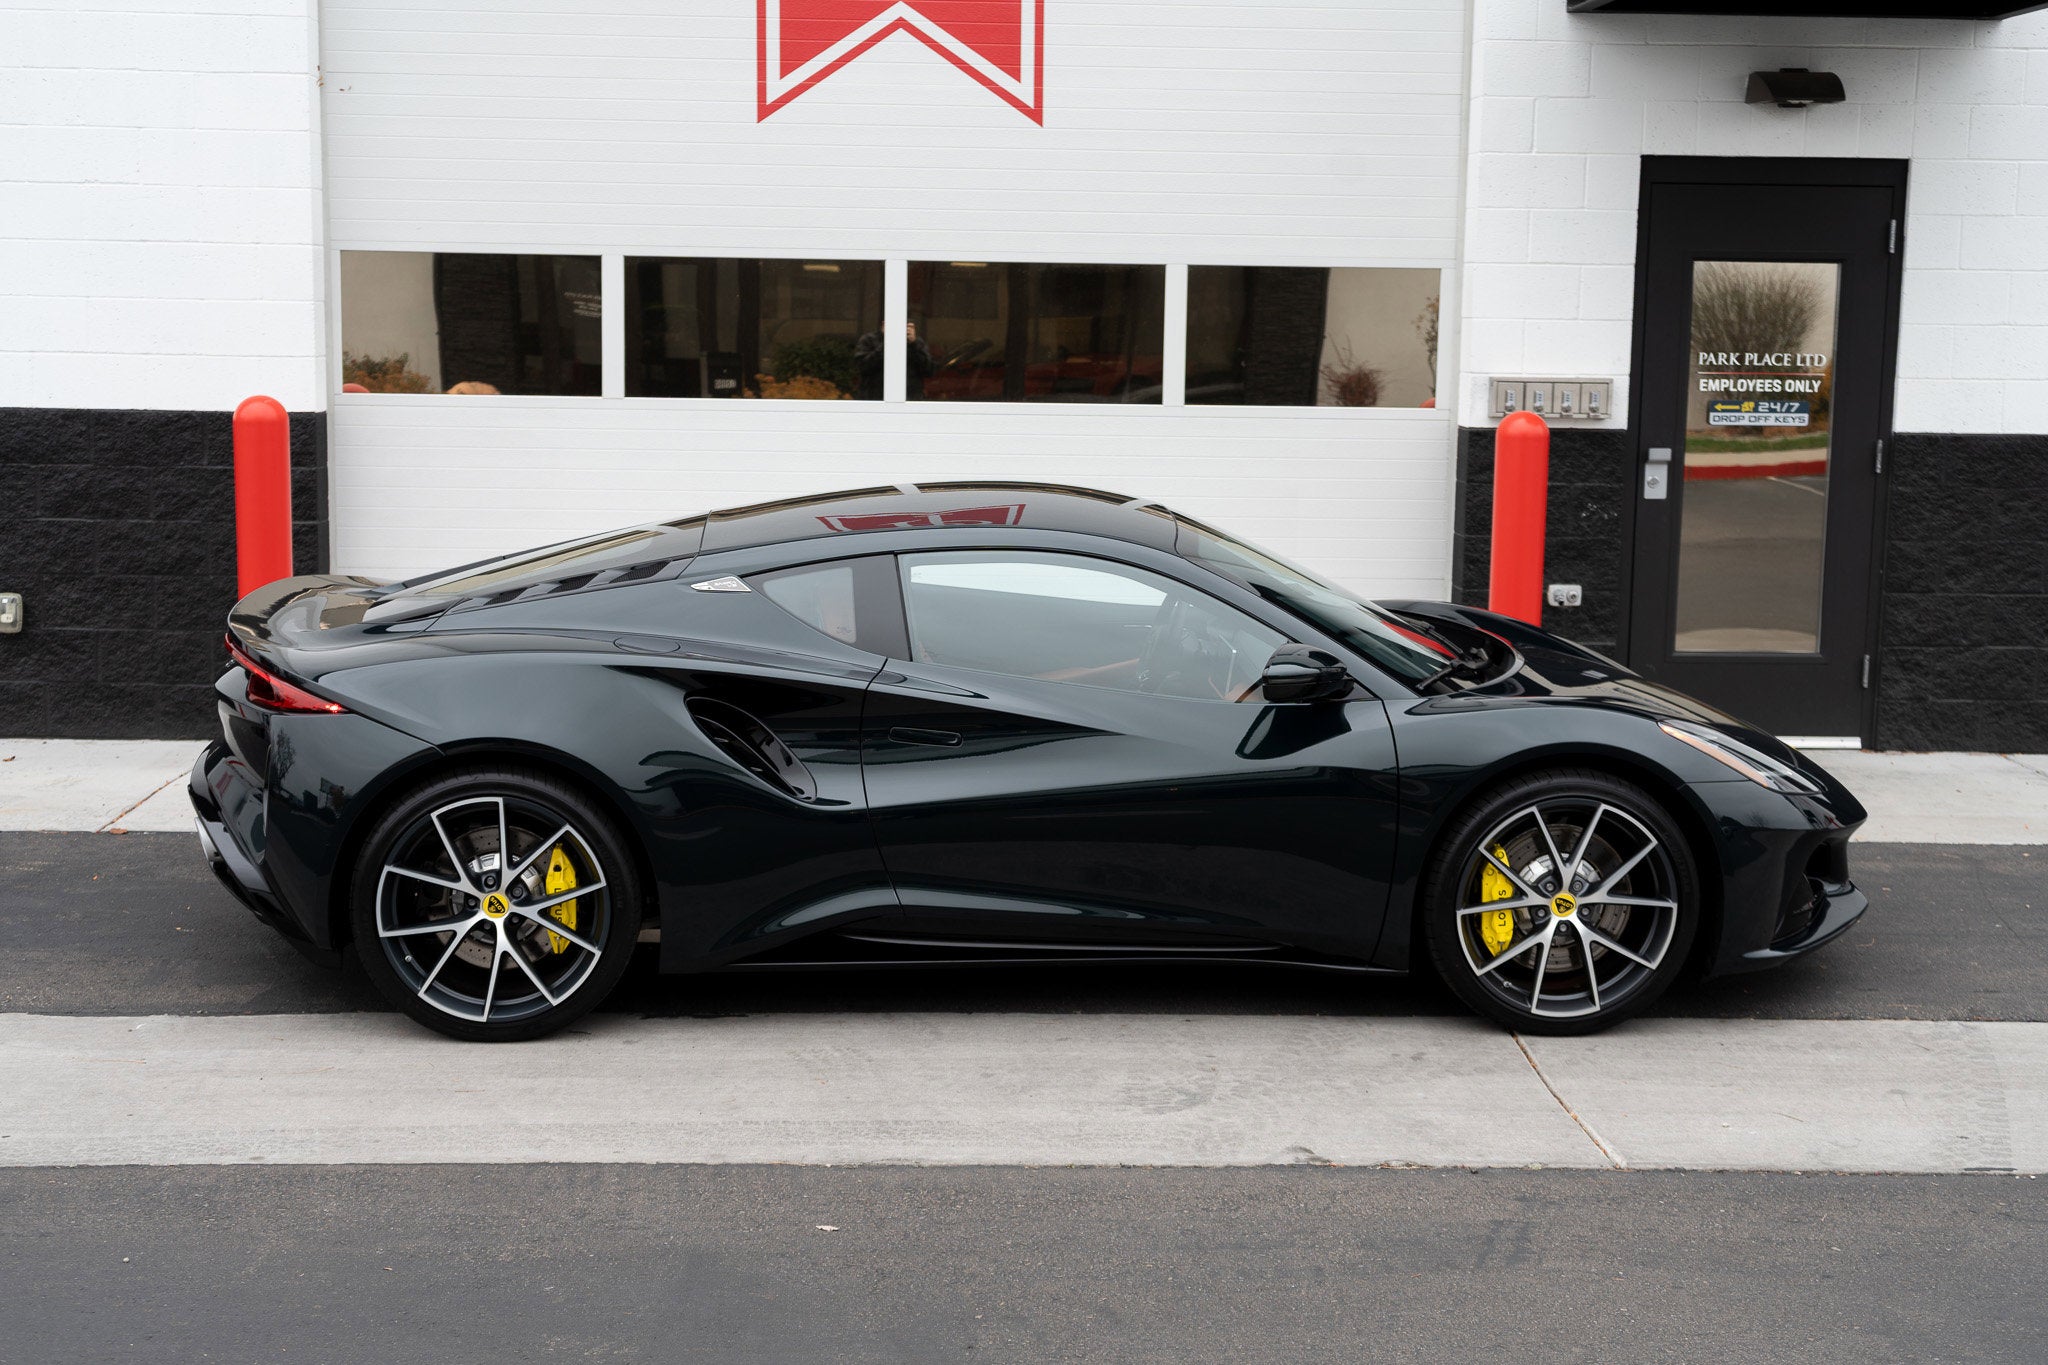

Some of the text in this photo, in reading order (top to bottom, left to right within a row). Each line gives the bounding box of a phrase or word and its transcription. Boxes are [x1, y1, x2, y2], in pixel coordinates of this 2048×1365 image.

[1698, 352, 1827, 367] PARK PLACE LTD
[1699, 378, 1822, 393] EMPLOYEES ONLY
[1758, 402, 1800, 412] 24/7
[1713, 415, 1745, 423] DROP
[1748, 415, 1772, 423] OFF
[554, 887, 563, 923] LUS
[1498, 890, 1506, 926] LOS
